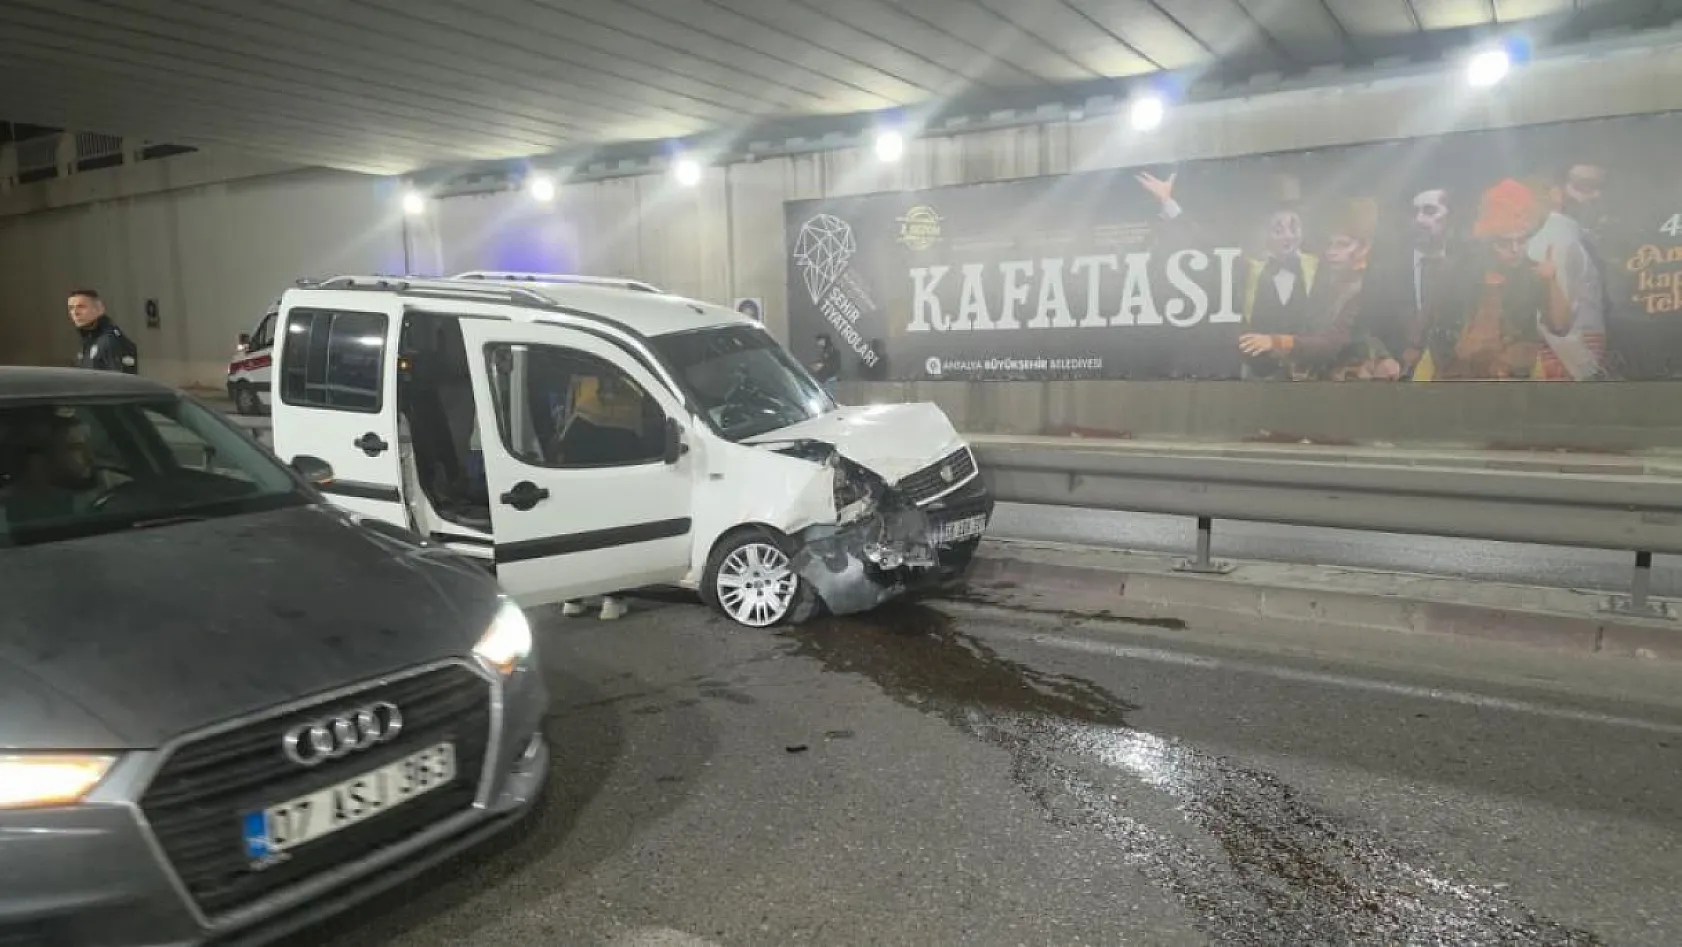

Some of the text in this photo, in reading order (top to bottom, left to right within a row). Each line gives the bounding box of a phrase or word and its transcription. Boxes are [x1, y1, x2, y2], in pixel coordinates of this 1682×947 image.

[907, 247, 1242, 331] KAFATASI
[271, 801, 313, 843] 07
[331, 771, 389, 822] ASJ
